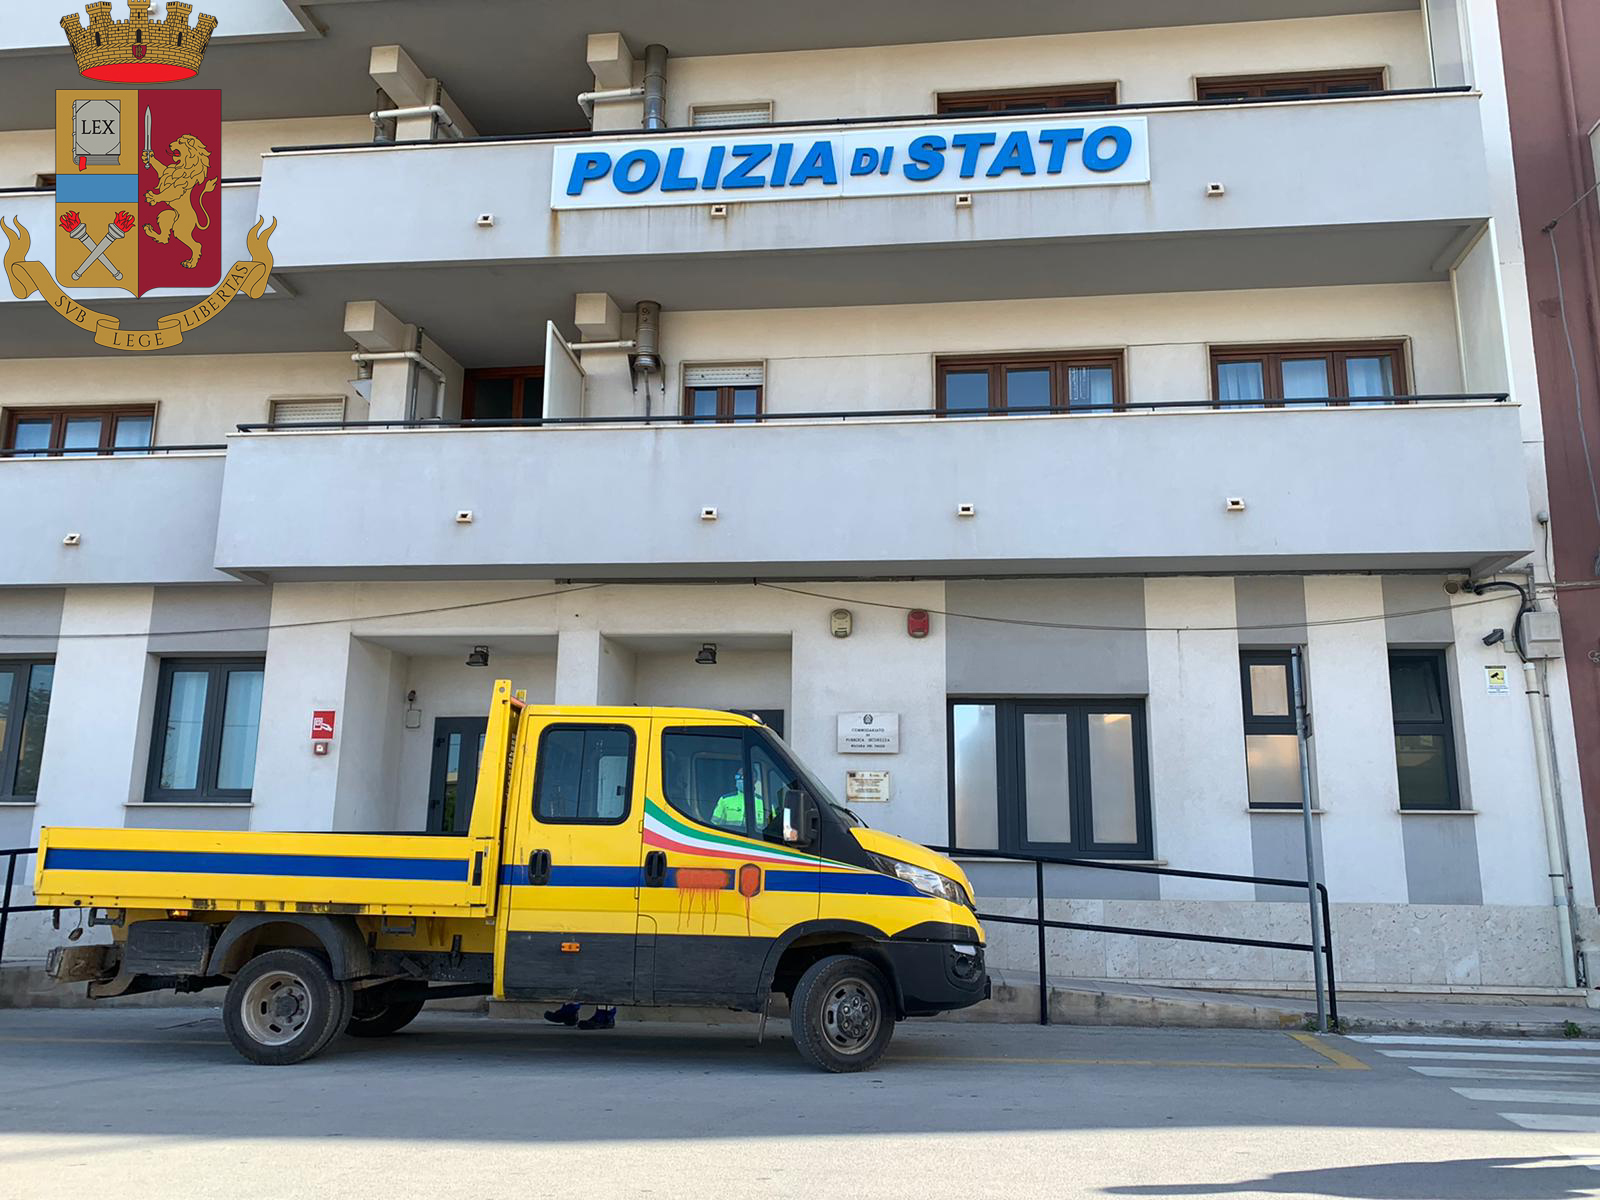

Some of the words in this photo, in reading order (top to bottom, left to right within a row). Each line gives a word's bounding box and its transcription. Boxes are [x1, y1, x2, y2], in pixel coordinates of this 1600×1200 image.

[566, 140, 838, 196] POLIZIA
[850, 146, 894, 176] DI
[903, 125, 1132, 181] STATO
